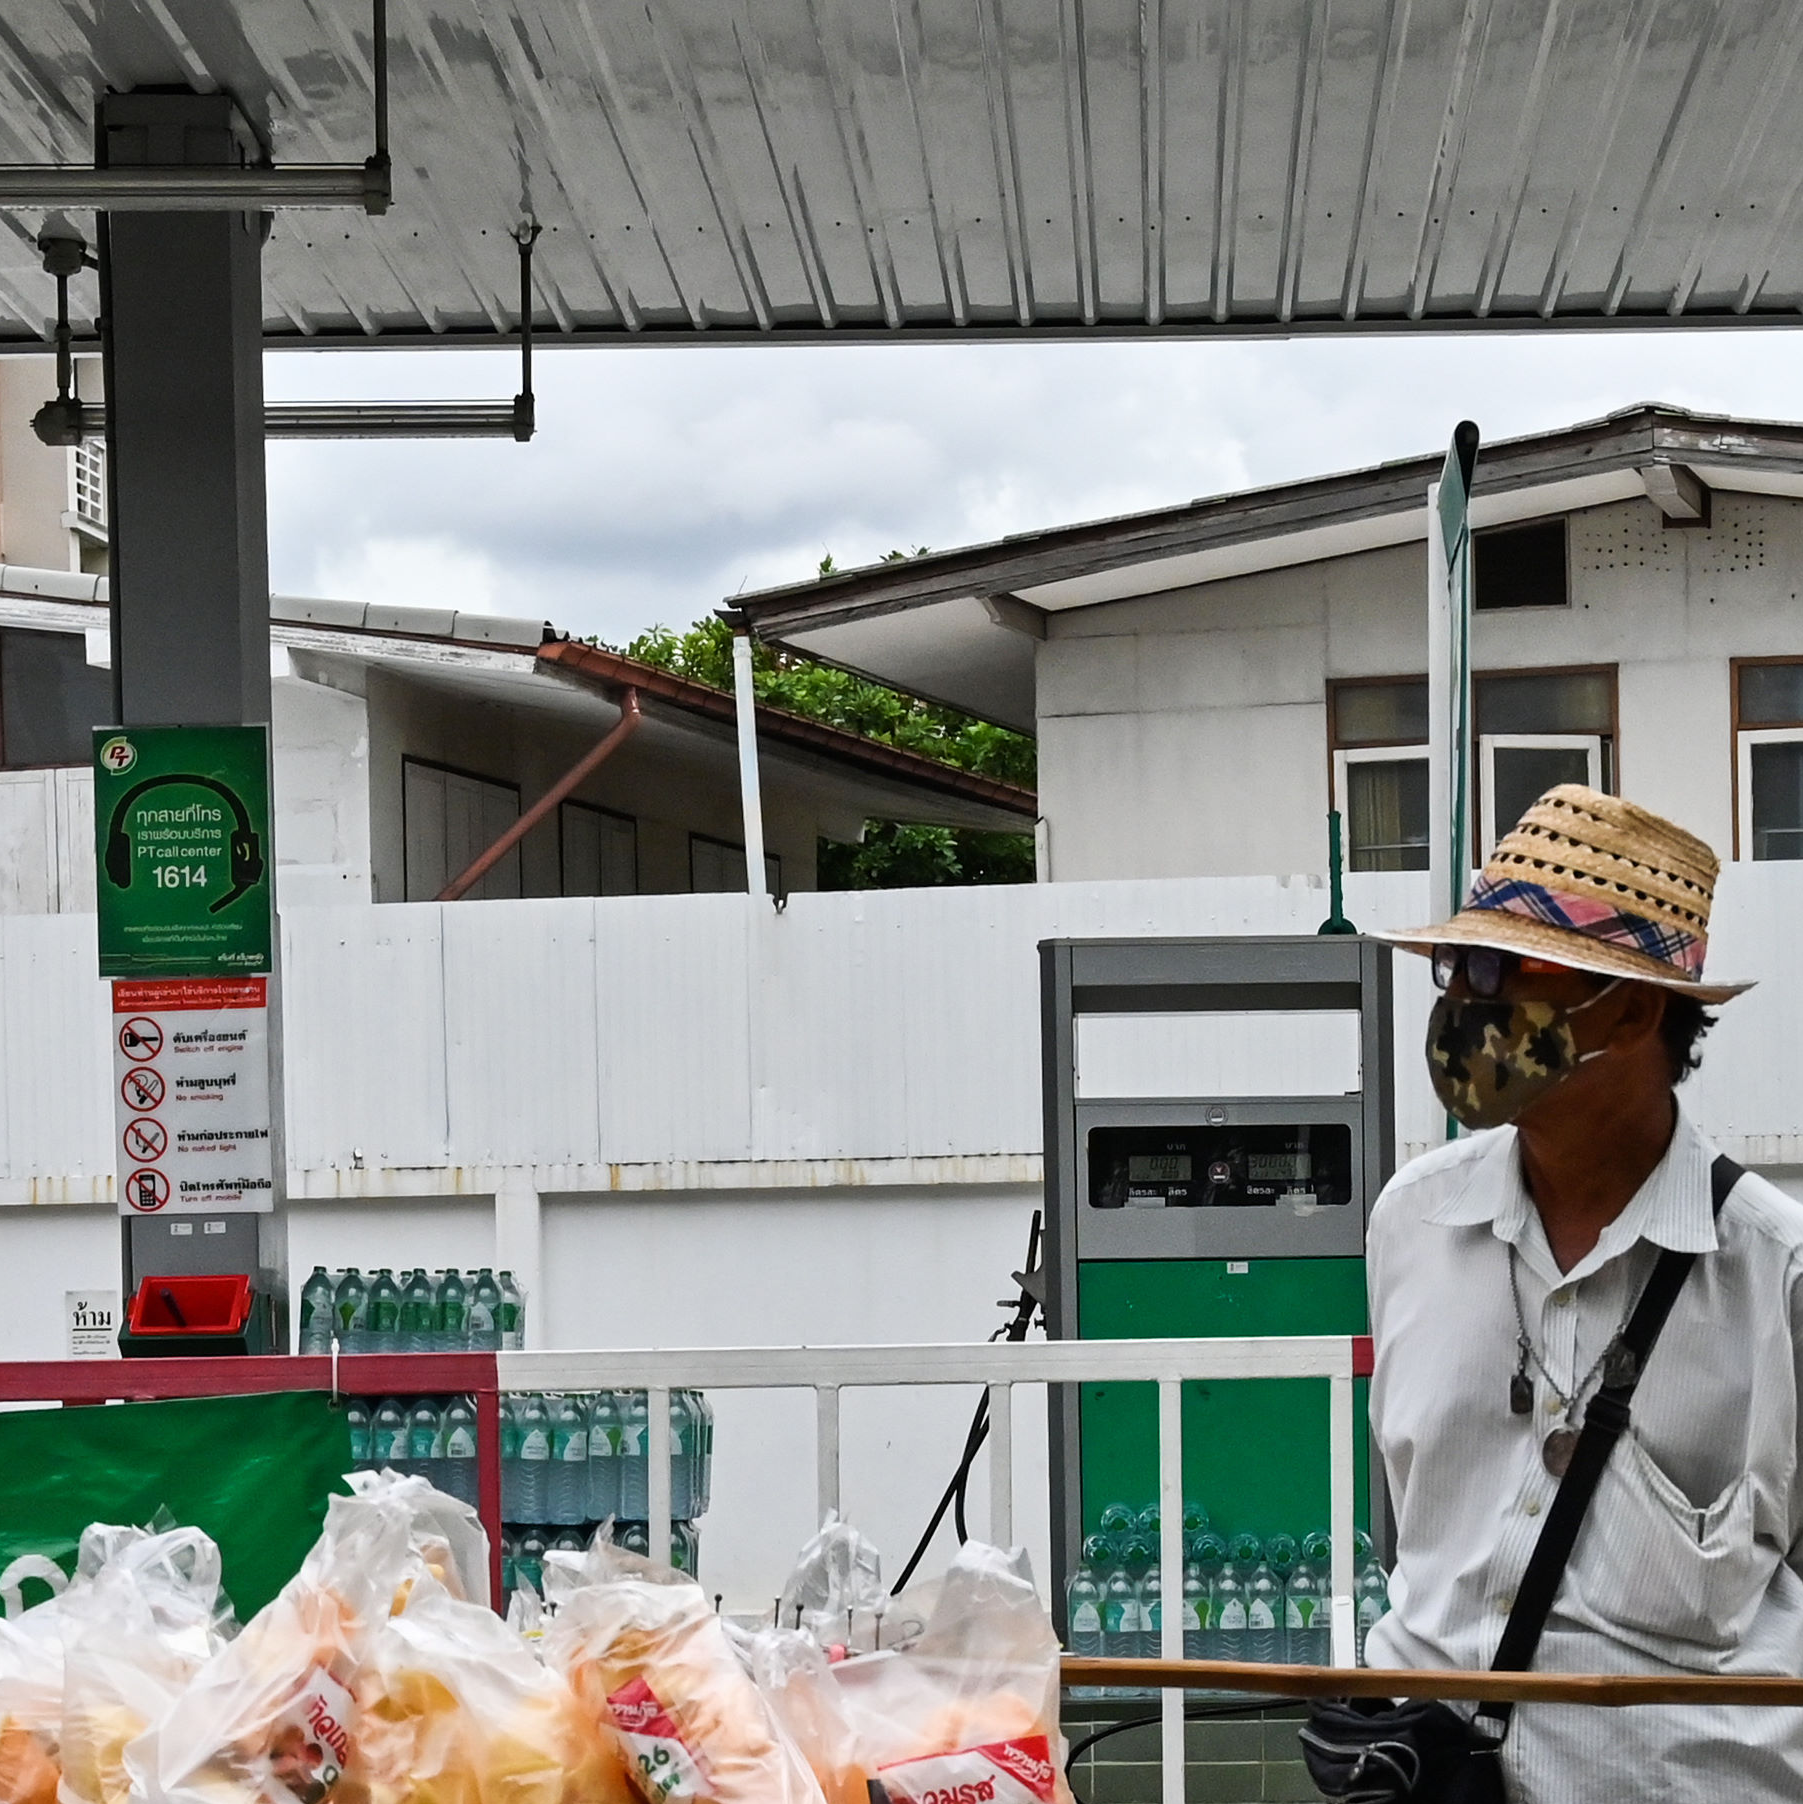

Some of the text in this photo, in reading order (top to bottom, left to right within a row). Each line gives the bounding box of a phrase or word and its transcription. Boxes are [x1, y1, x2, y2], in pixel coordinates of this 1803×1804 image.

[109, 745, 129, 767] PT
[136, 803, 222, 827] ทุกสายที่โทร
[138, 827, 222, 841] เราพร้อมบริการ
[137, 845, 222, 858] PT call center
[152, 864, 208, 889] 1614
[172, 1029, 248, 1044] ดับเครื่องยนต์
[217, 1045, 244, 1053] engine
[175, 1072, 237, 1090] ห้ามสูบบุหรี่
[190, 1093, 224, 1102] smoking
[176, 1128, 269, 1142] ห้ามก่อประกายไฟ
[177, 1145, 189, 1153] No
[219, 1144, 237, 1153] light
[179, 1195, 198, 1203] Turn
[72, 1300, 112, 1327] ห้าม
